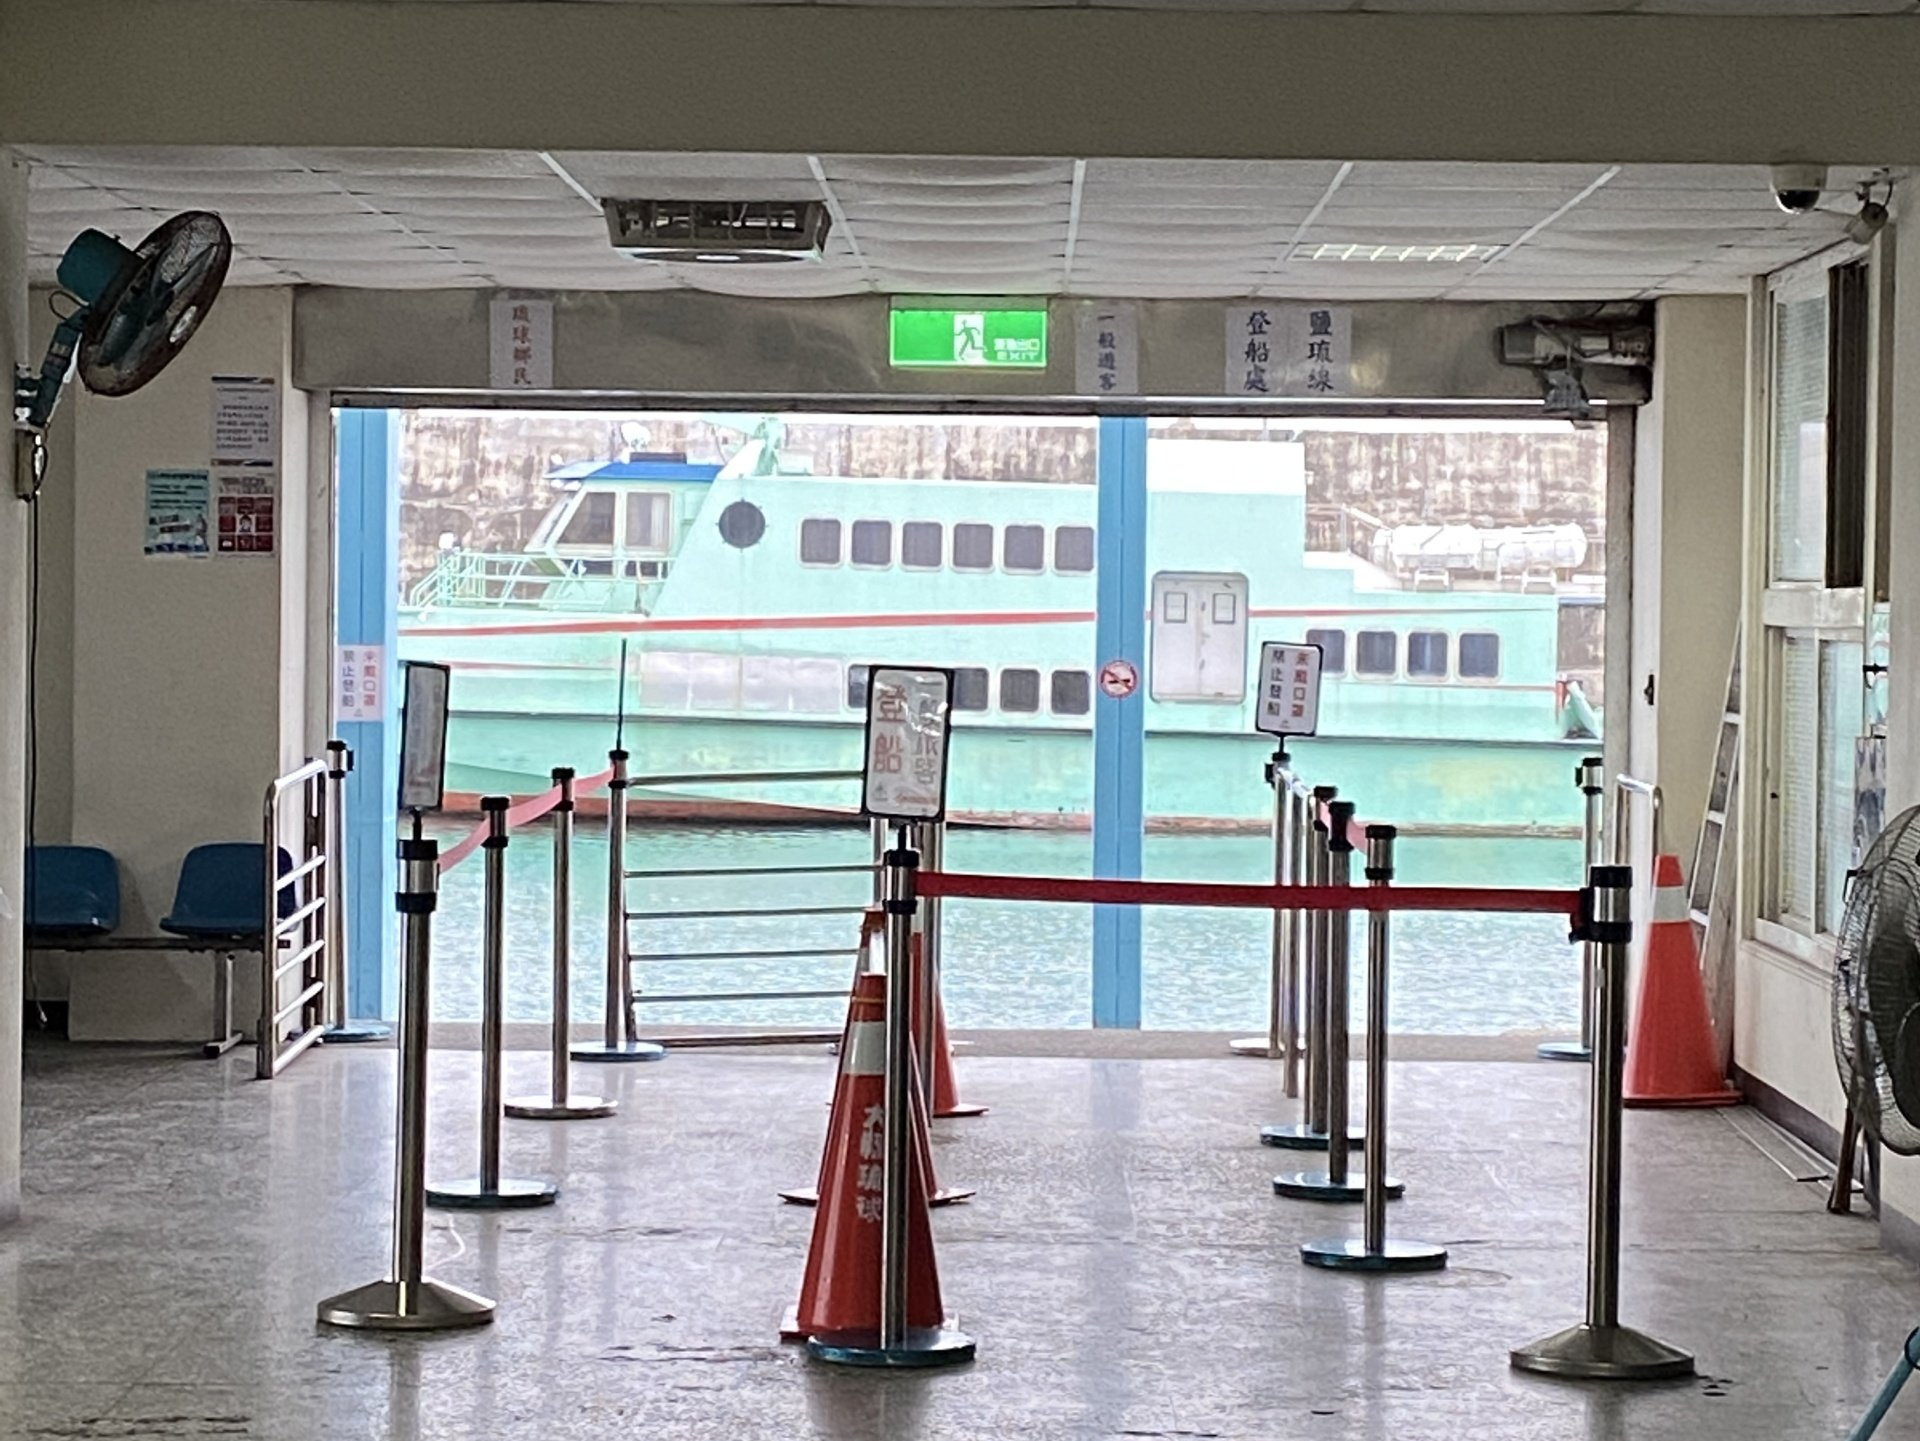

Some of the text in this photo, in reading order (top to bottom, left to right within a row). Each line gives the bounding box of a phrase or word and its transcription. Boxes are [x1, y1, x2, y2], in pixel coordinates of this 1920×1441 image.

[996, 351, 1039, 361] EXIT
[1243, 310, 1271, 392] 登船處
[1307, 310, 1334, 392] 鹽琉線
